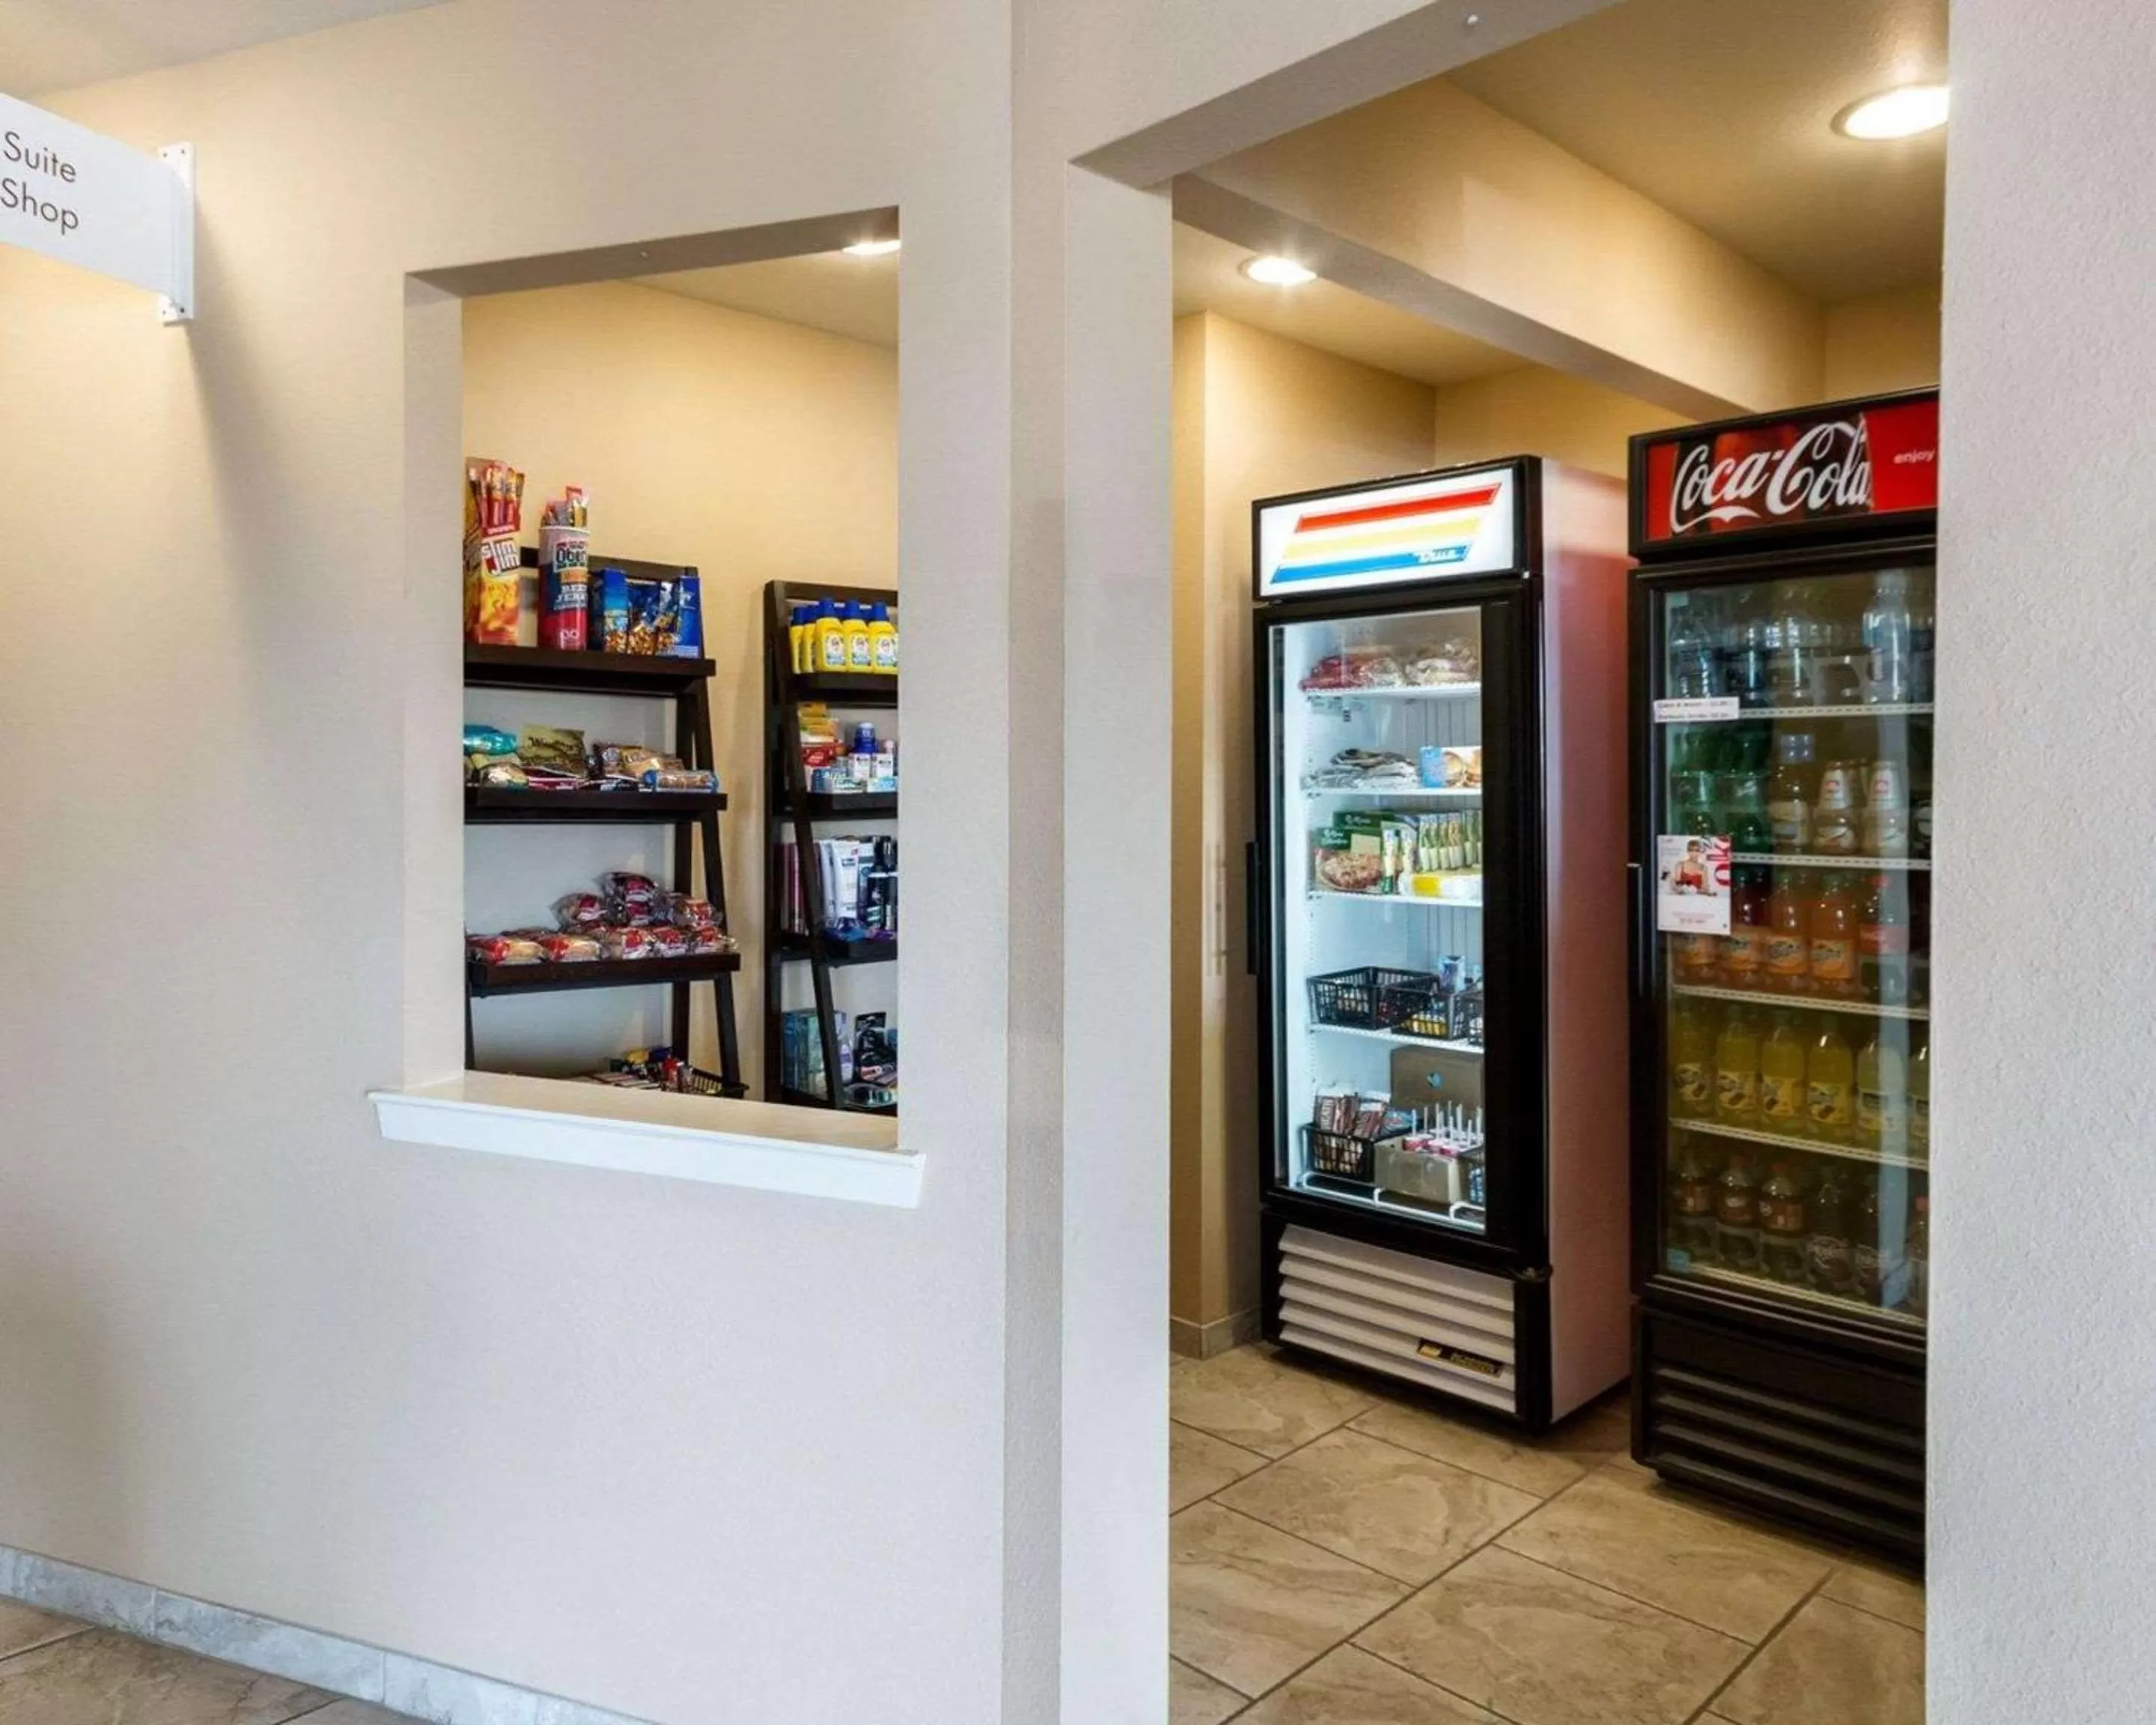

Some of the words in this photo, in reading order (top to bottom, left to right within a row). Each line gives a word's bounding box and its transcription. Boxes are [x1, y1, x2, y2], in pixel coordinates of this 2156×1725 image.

[4, 130, 76, 183] Suite
[1, 177, 79, 235] Shop
[1670, 421, 1871, 533] Coca-Cola
[1893, 448, 1936, 464] enjoy
